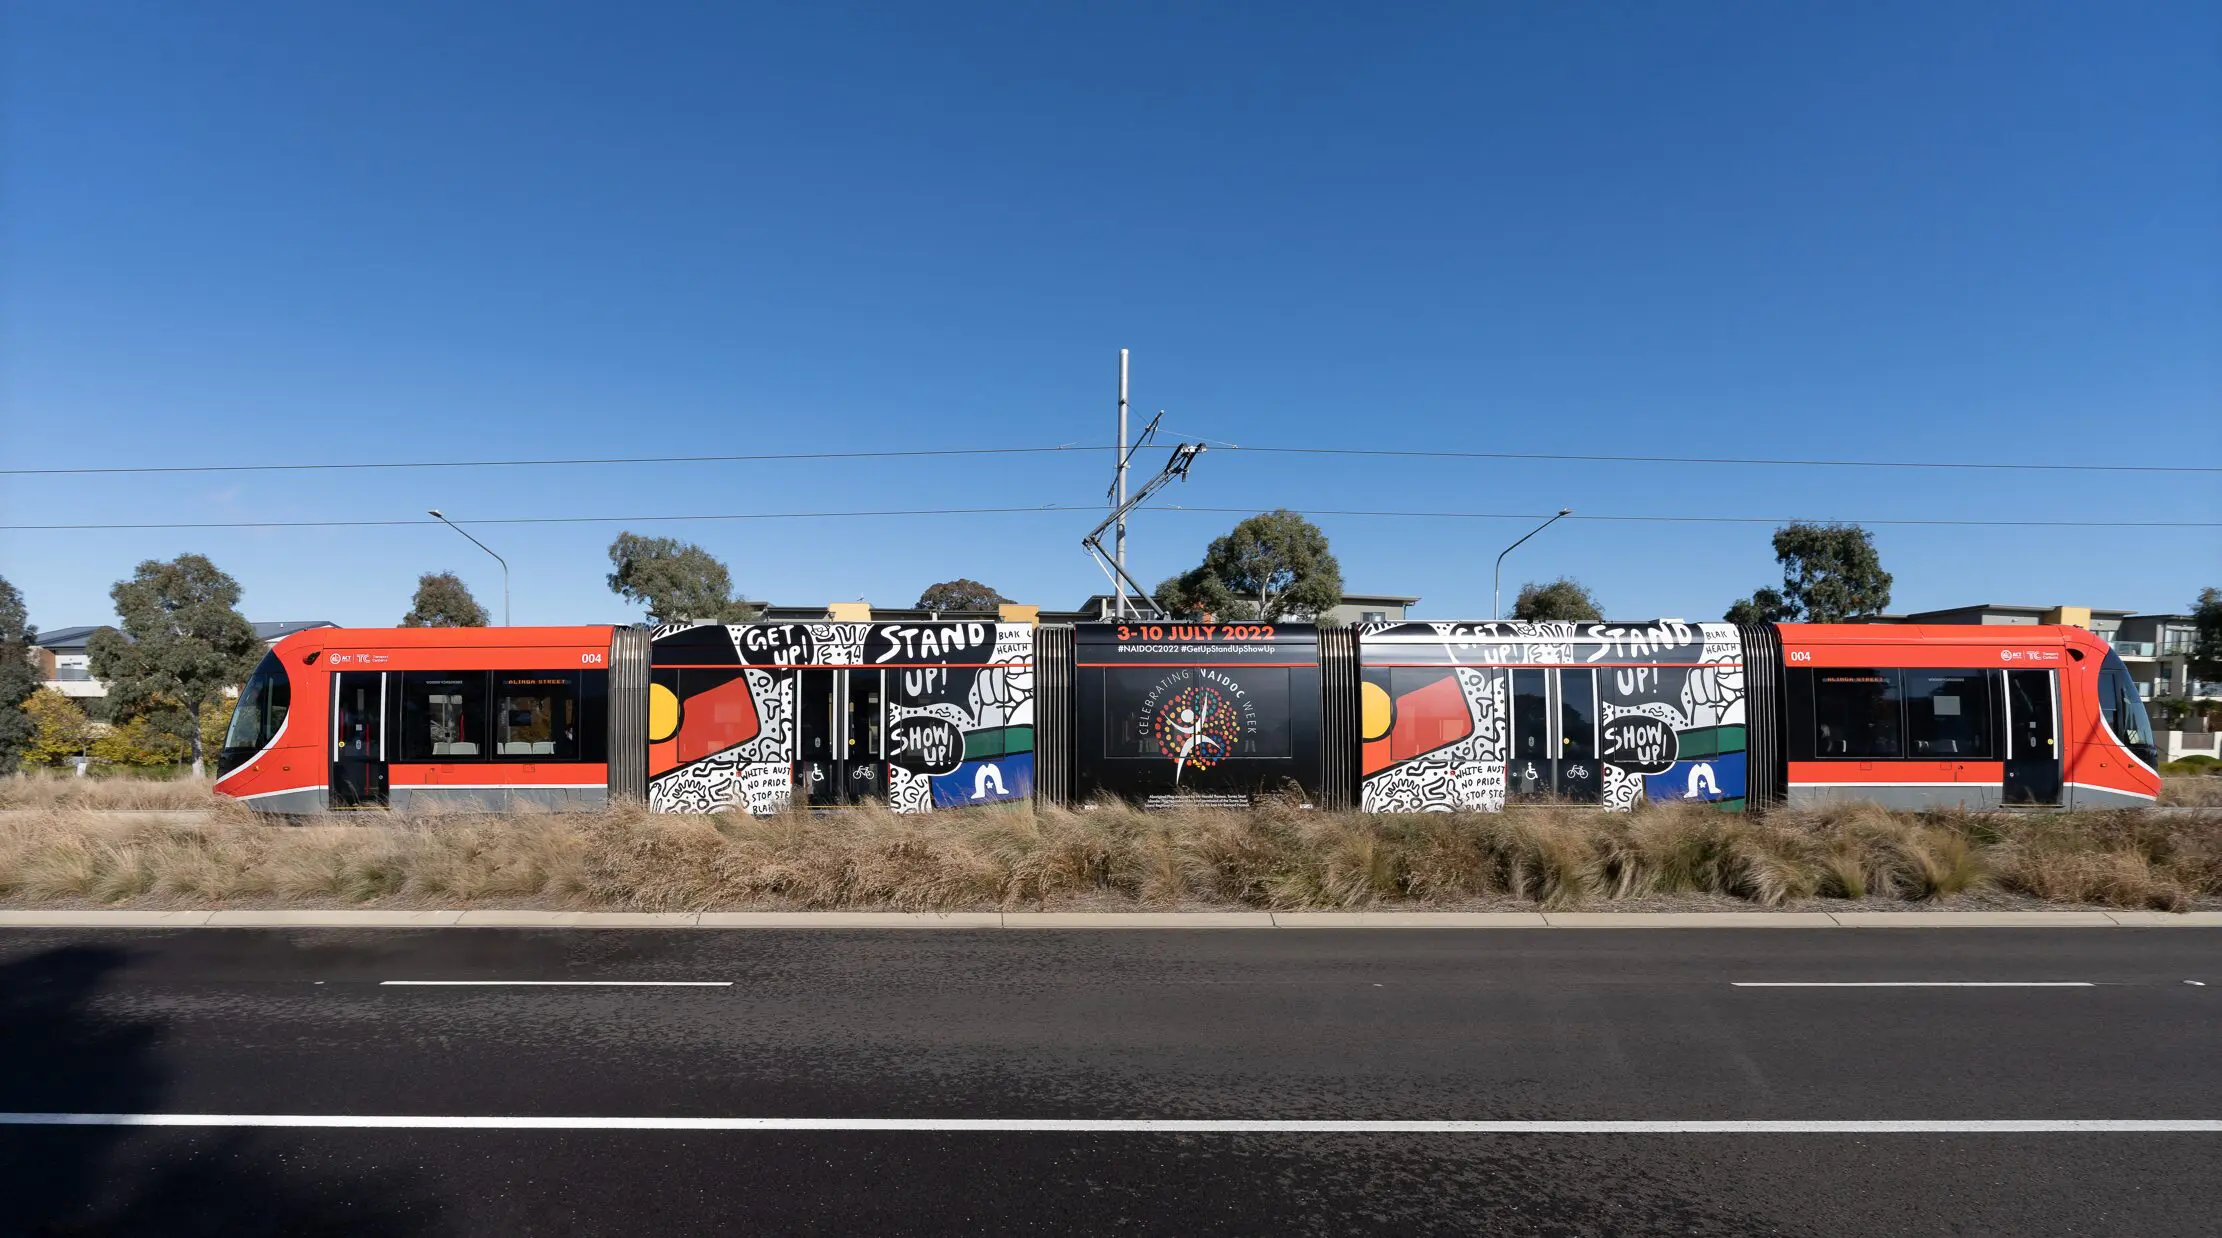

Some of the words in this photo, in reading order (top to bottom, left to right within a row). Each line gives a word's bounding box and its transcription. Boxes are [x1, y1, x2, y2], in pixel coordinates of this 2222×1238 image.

[747, 625, 794, 651] GET
[998, 631, 1020, 641] BLAK
[1117, 626, 1162, 641] 3-10
[1168, 626, 1216, 641] JULY
[1222, 626, 1275, 641] 2022
[1705, 631, 1727, 641] BLAK
[875, 623, 985, 664] STAND
[997, 643, 1028, 654] HEALTH
[1118, 645, 1179, 653] #NAIDOC2022
[1181, 645, 1276, 655] #GetUpStandUpShowUp
[1586, 623, 1693, 663] STAND
[1706, 643, 1737, 654] HEALTH
[581, 653, 602, 664] 004
[773, 635, 808, 671] UP!
[1791, 651, 1811, 661] 004
[905, 660, 947, 697] UP!
[1617, 660, 1658, 696] UP!
[1139, 669, 1189, 735] CELEBRATING
[1199, 668, 1245, 698] NAIDOC
[1242, 700, 1257, 734] WEEK
[890, 722, 949, 756] SHOW
[1604, 722, 1662, 755] SHOW
[923, 734, 953, 766] UP!
[1637, 733, 1667, 765] UP!
[741, 767, 769, 781] WHITE
[1454, 766, 1483, 780] WHITE
[748, 780, 759, 790] NO
[762, 778, 786, 787] PRIDE
[1461, 780, 1473, 789] NO
[1476, 777, 1500, 786] PRIDE
[752, 791, 771, 802] STOP
[1465, 790, 1485, 801] STOP
